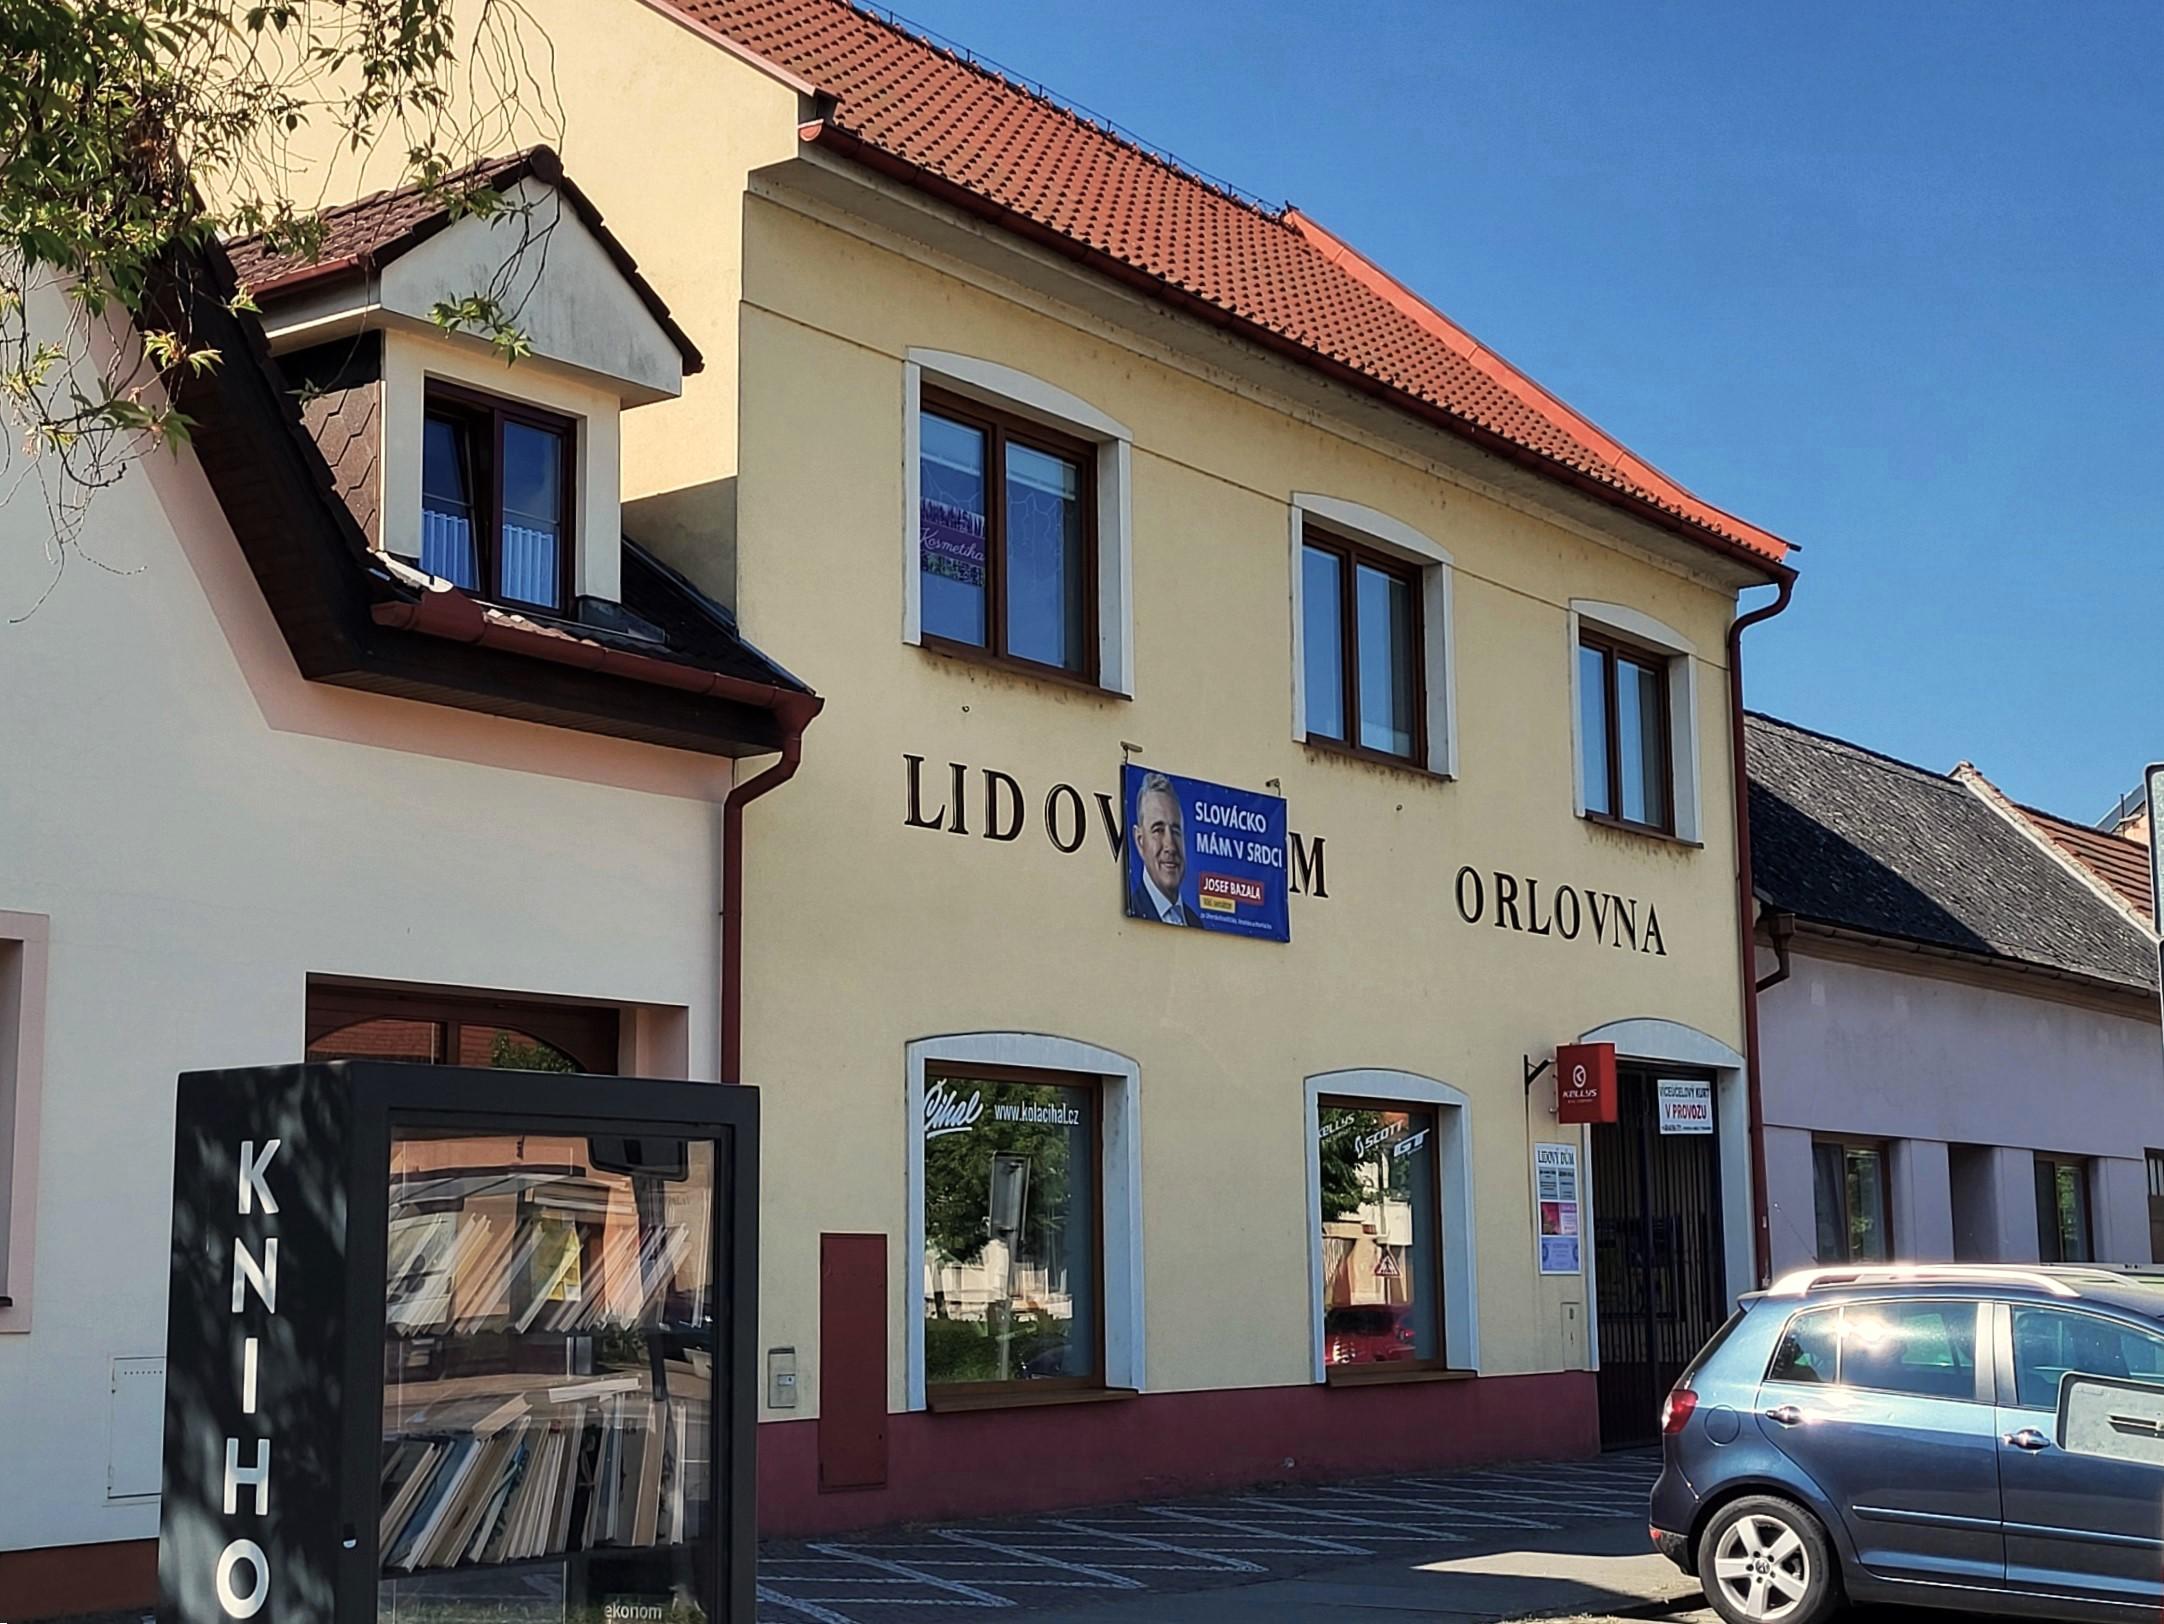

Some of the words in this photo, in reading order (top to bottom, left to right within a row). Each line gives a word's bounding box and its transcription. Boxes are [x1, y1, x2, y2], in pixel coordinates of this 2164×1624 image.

[920, 527, 985, 561] Kosmetika
[903, 754, 1124, 863] LIDOV
[1195, 801, 1267, 833] SLOVÁCKO
[1196, 832, 1233, 859] MÁM
[1233, 840, 1243, 860] V
[1247, 843, 1282, 868] SRDCI
[1203, 877, 1229, 893] JOSEF
[1230, 882, 1261, 900] BAZALA
[1455, 865, 1668, 956] ORLOVNA
[994, 1101, 1080, 1125] www.kolacihal.cz
[1665, 1103, 1671, 1119] V
[1672, 1103, 1707, 1120] PROVOZU
[1365, 1119, 1404, 1149] SCOTT
[1393, 1128, 1430, 1157] GT
[604, 1601, 662, 1619] ekonom
